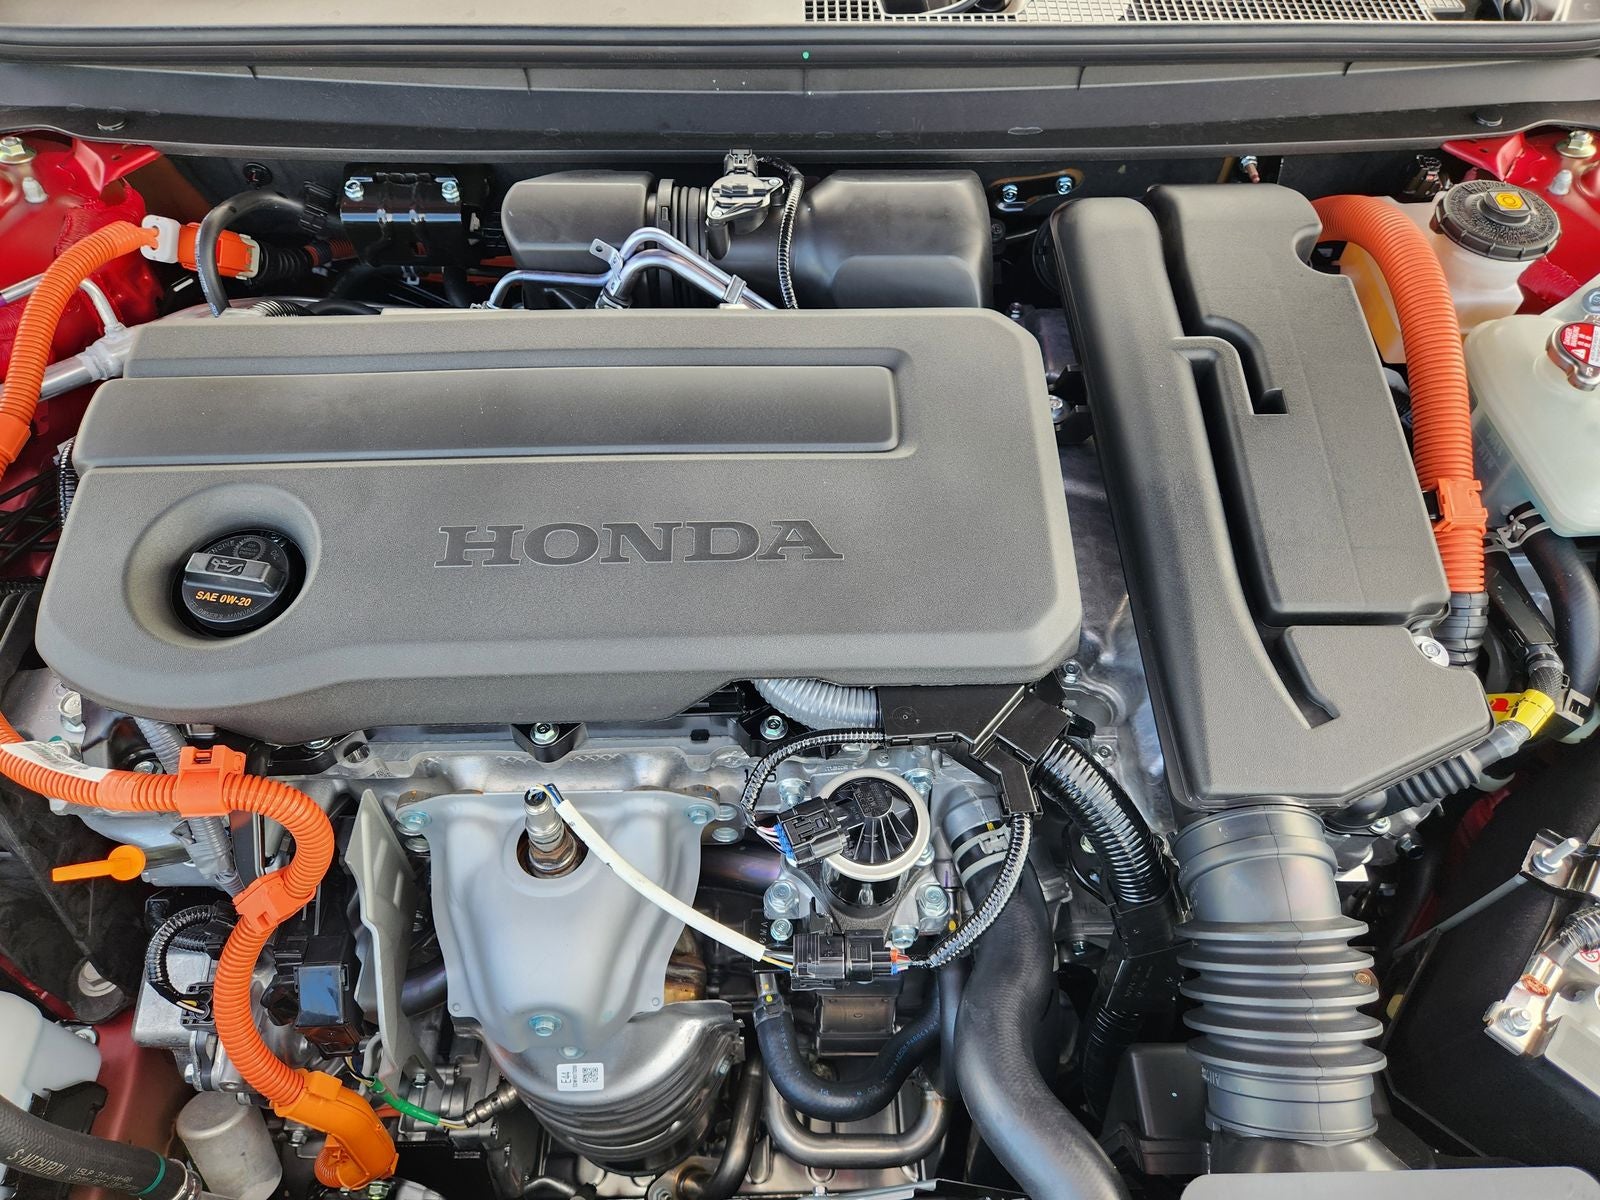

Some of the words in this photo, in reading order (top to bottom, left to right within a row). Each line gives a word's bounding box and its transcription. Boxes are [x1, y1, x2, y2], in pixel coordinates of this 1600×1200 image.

[207, 540, 235, 554] ENGINE
[434, 519, 844, 568] HONDA
[195, 590, 219, 602] SAE
[219, 594, 252, 607] 0W-20
